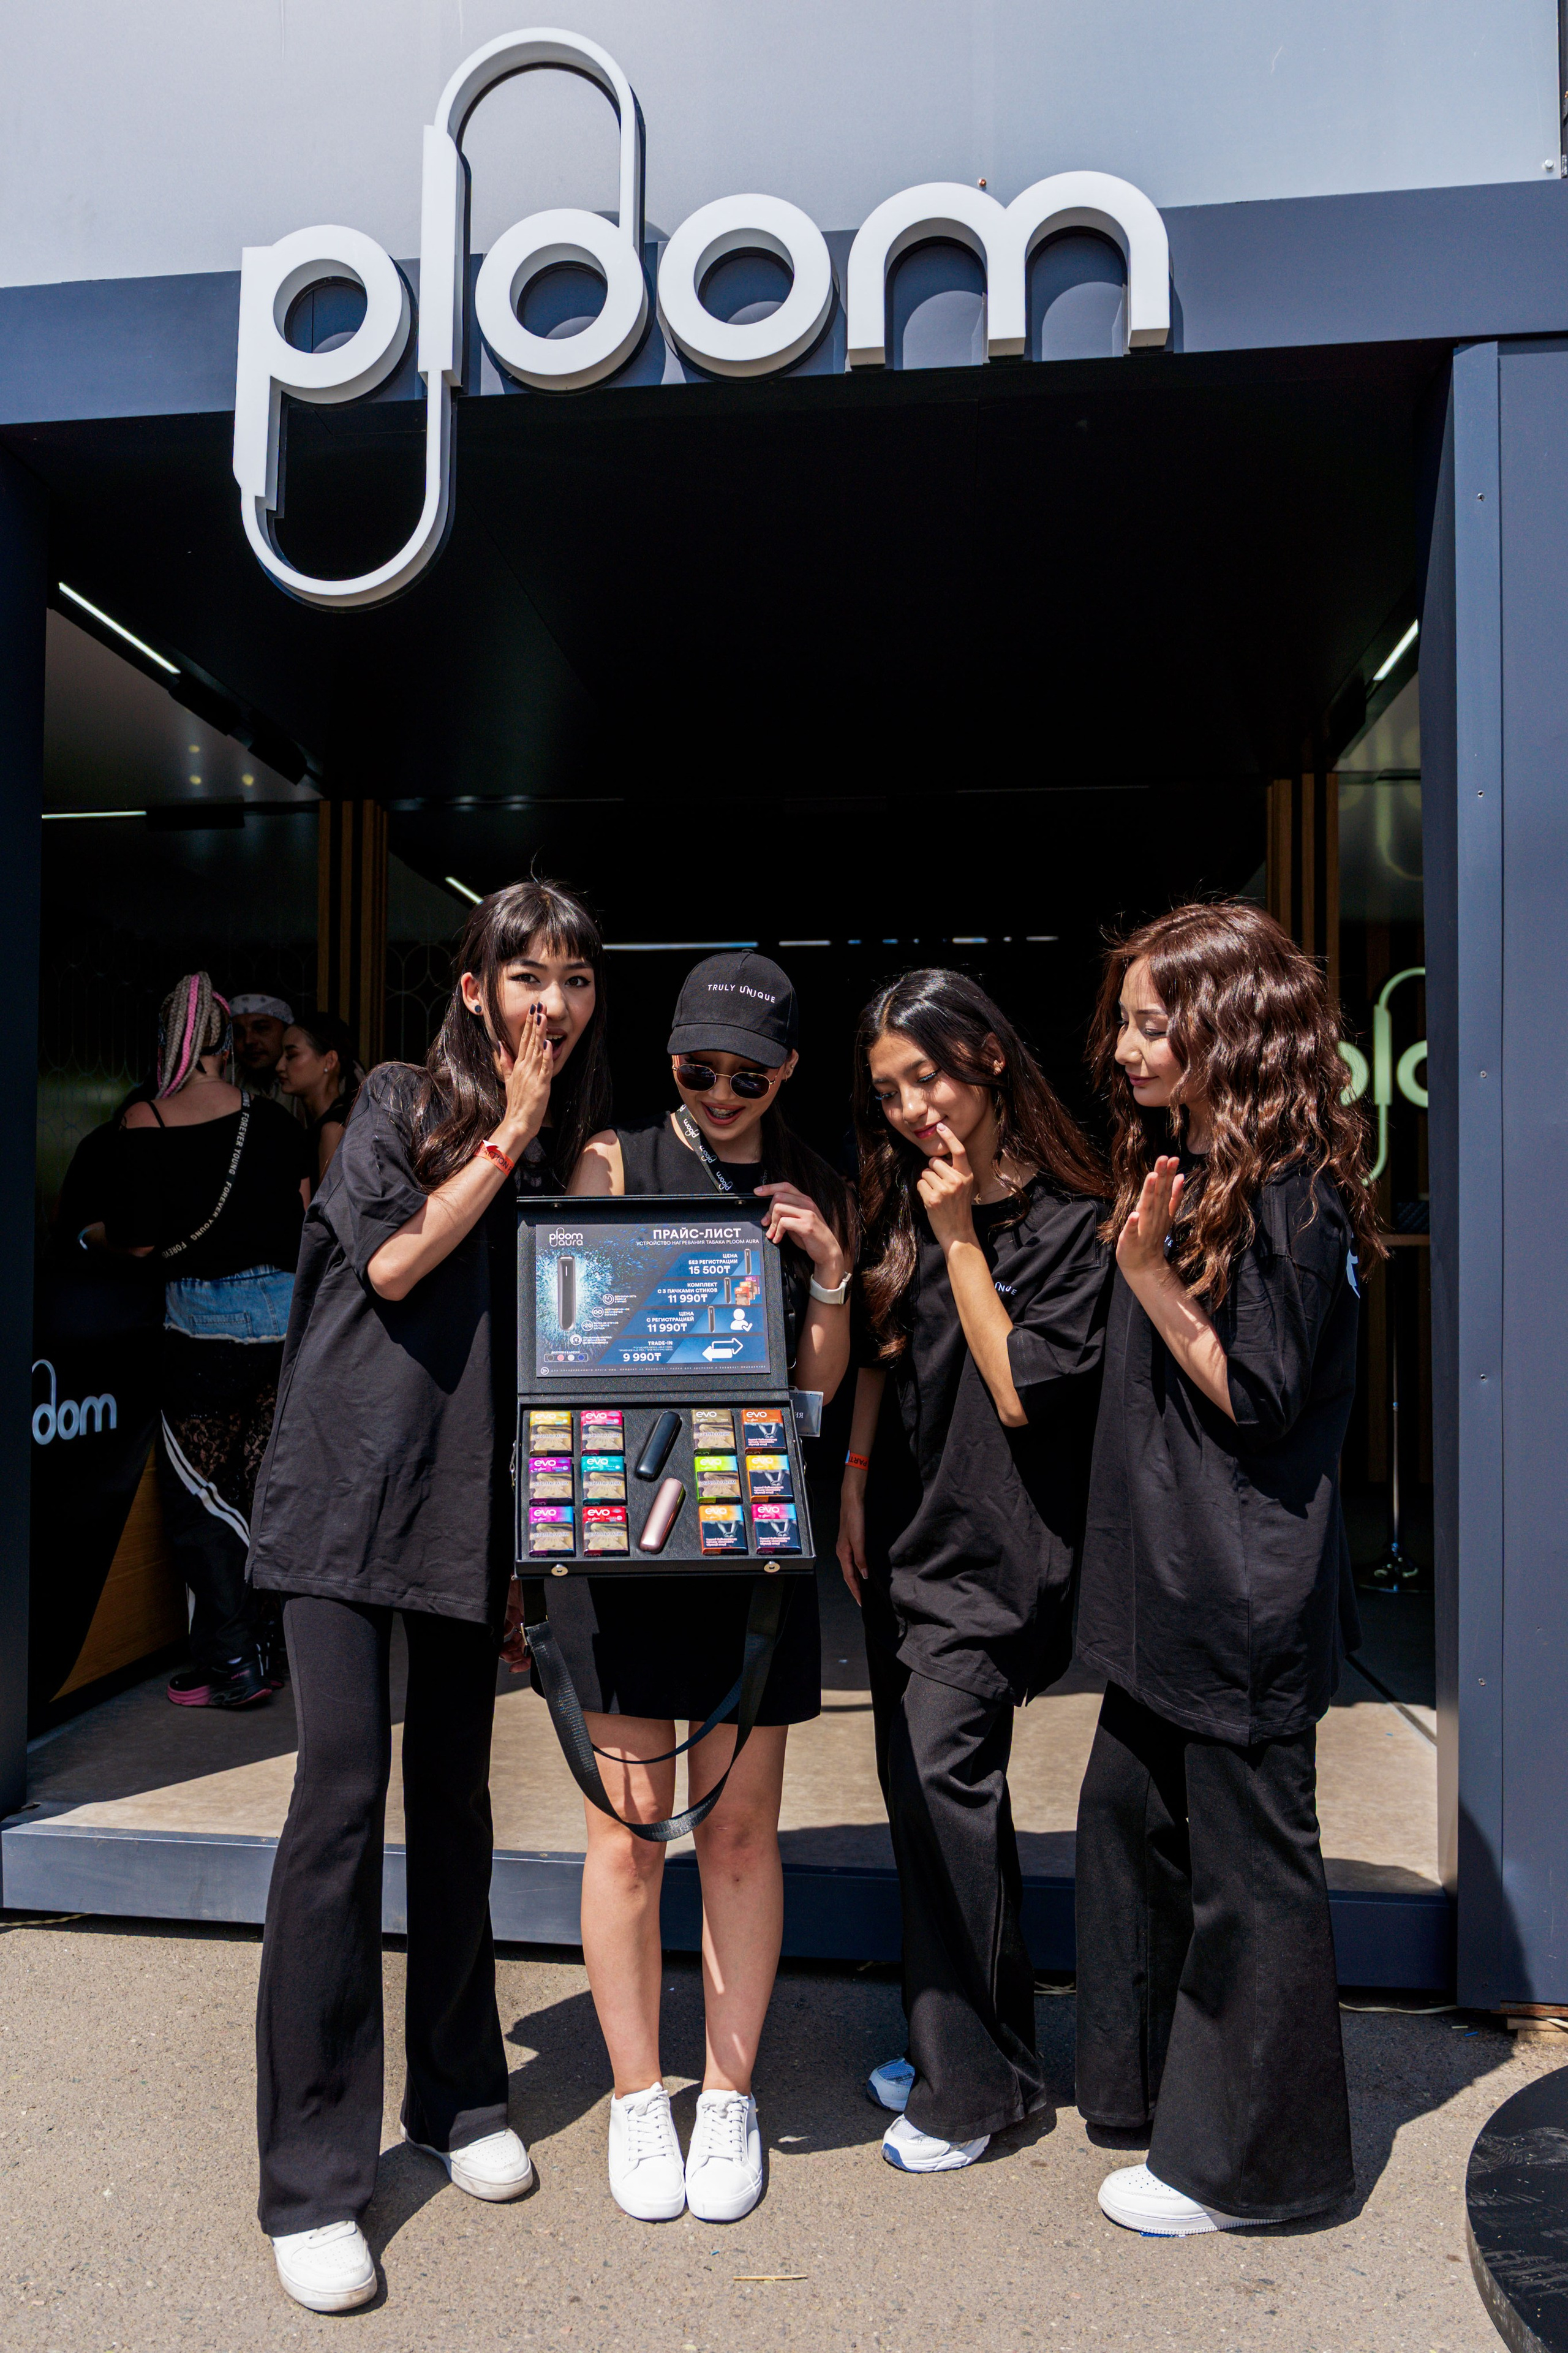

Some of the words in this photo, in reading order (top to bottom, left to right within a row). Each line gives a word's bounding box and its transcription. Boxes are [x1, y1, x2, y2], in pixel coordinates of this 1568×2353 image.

[233, 27, 1171, 611] ploom
[739, 985, 775, 1003] UNIQUE
[236, 1112, 249, 1147] FOREVER
[228, 1149, 241, 1175] YOUNG
[213, 1181, 232, 1217] FOREVER
[190, 1219, 214, 1241] YOUNG
[549, 1227, 583, 1247] ploom
[653, 1228, 741, 1239] ПРАЙС-ЛИСТ
[668, 1294, 677, 1303] 11
[647, 1324, 657, 1332] 11
[623, 1353, 630, 1362] 9
[32, 1359, 117, 1445] oom
